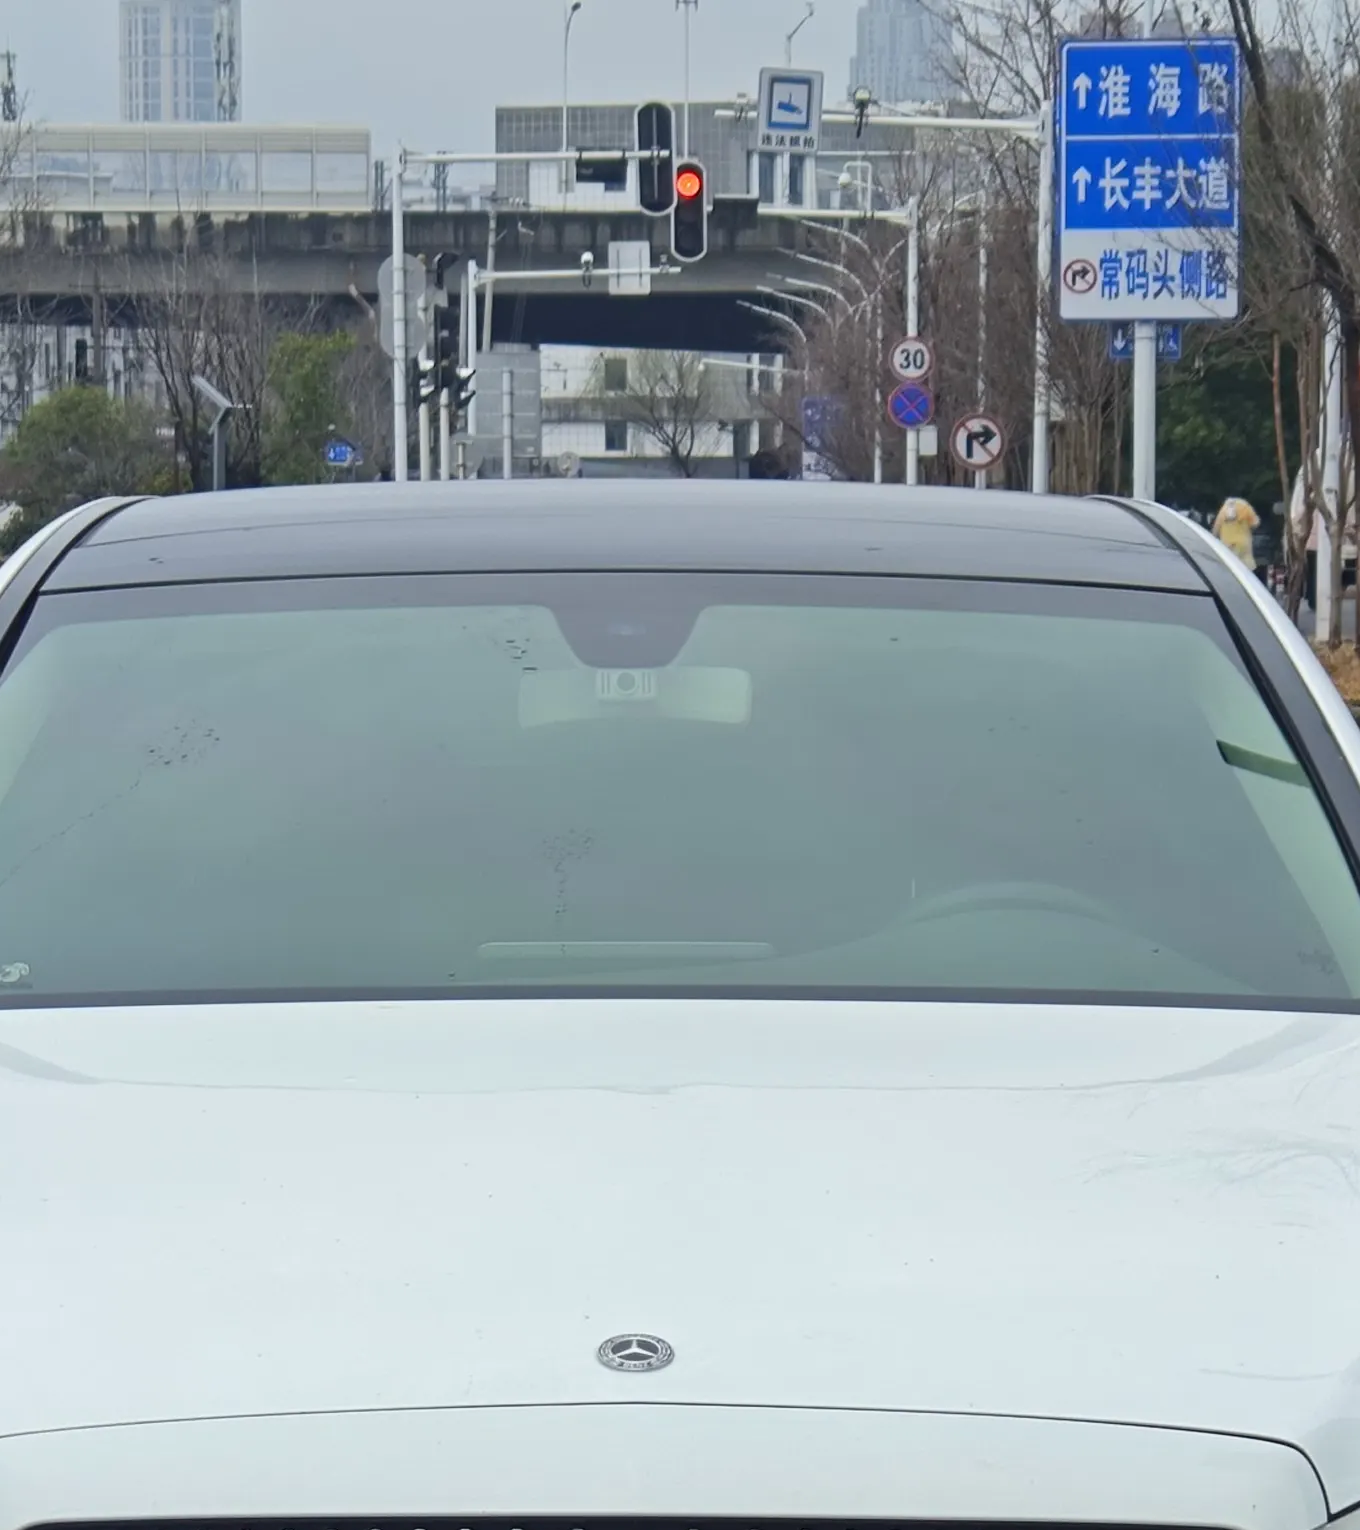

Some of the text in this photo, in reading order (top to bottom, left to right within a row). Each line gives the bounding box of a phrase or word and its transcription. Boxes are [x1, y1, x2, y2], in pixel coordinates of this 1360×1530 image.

[1098, 62, 1229, 118] 淮海路
[1098, 156, 1230, 212] 长丰大道
[1099, 248, 1228, 300] 常码头侧路
[899, 347, 925, 370] 30
